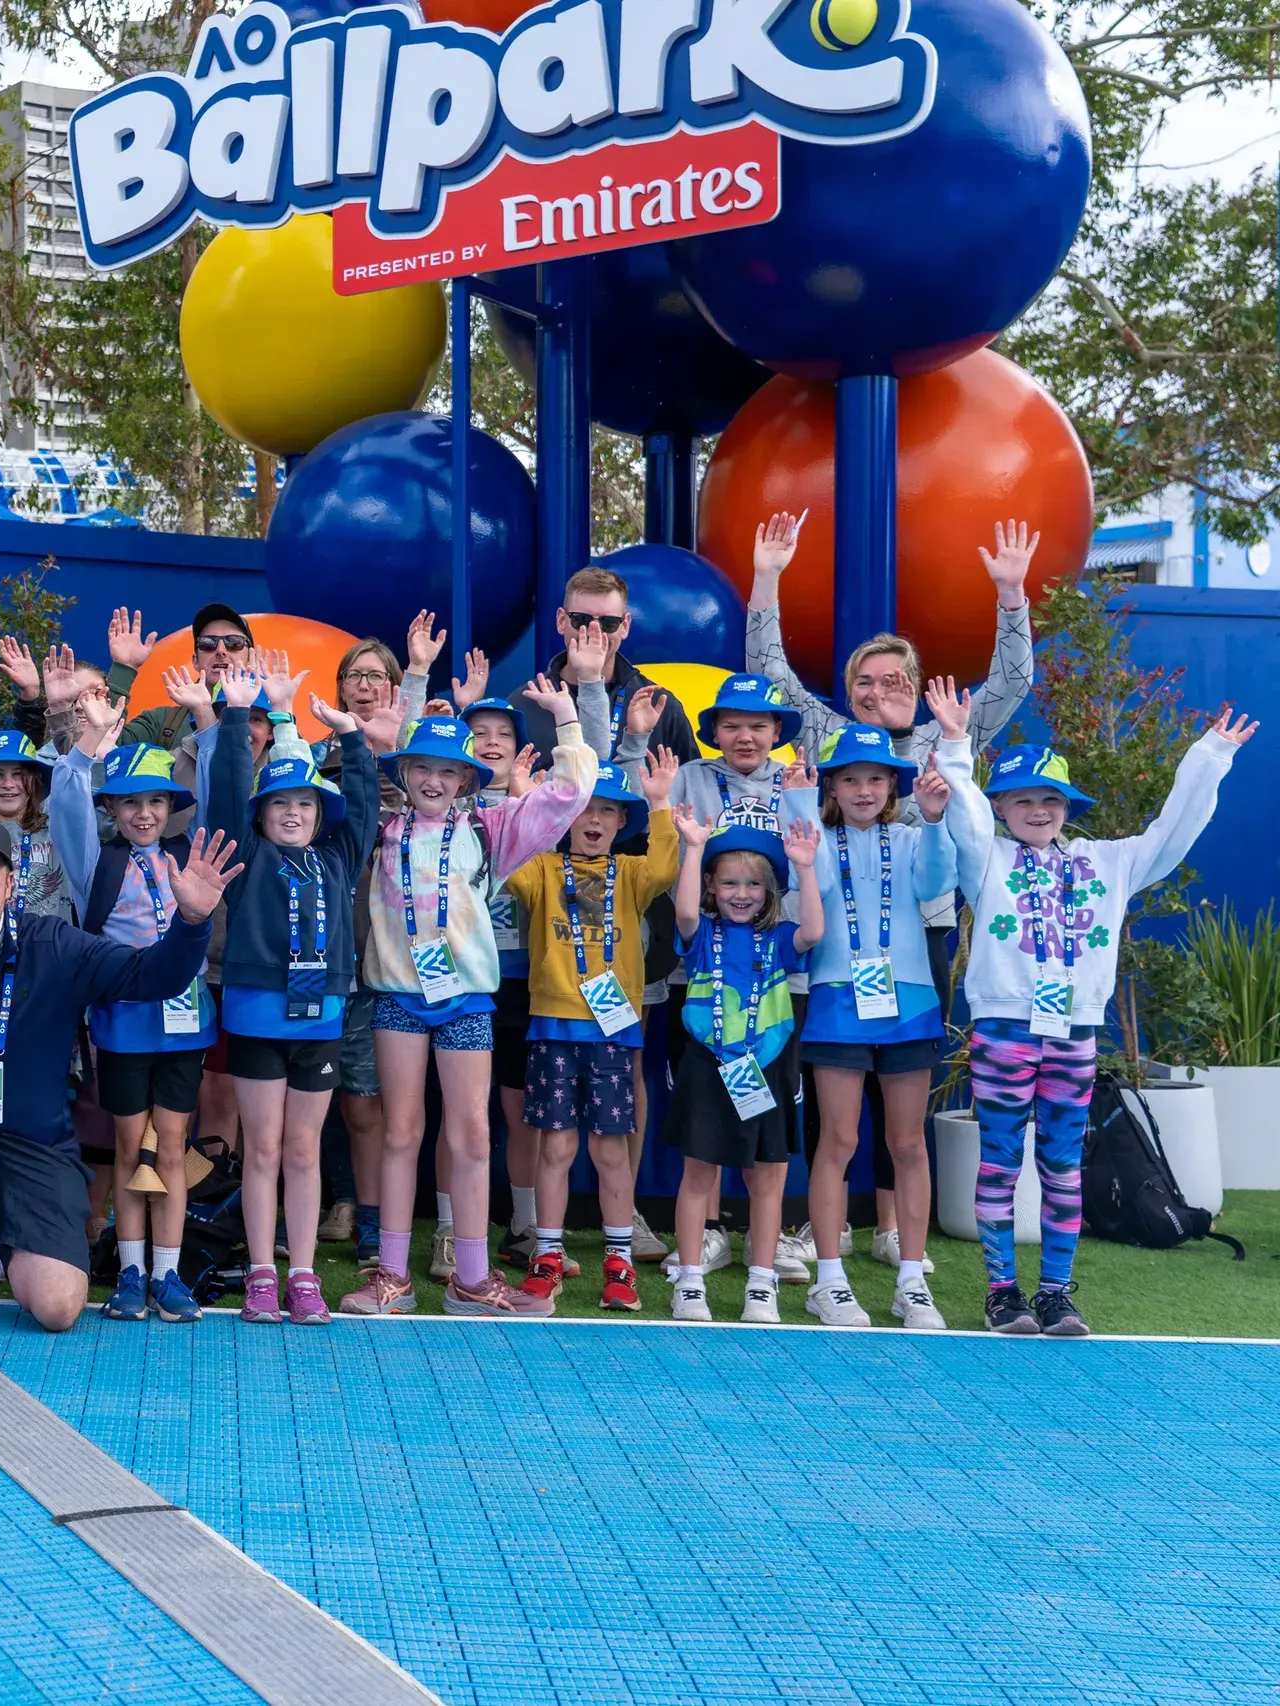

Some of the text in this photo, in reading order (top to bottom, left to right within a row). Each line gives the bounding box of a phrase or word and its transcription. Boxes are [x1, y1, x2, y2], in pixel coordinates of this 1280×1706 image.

[194, 15, 276, 80] AO
[74, 0, 904, 246] Ballpark
[500, 161, 763, 253] Emirates
[343, 243, 488, 282] PRESENTED BY
[614, 713, 619, 721] AO
[771, 803, 776, 811] AO
[24, 836, 28, 844] AO
[841, 852, 846, 861] AO
[883, 849, 889, 857] AO
[142, 863, 148, 871] AO
[1027, 858, 1033, 867] AO
[22, 867, 27, 876] AO
[441, 864, 447, 873] AO
[609, 866, 614, 875] AO
[1065, 863, 1070, 873] AO
[404, 874, 409, 883] AO
[567, 877, 572, 885] AO
[291, 887, 296, 897] AO
[318, 889, 322, 898] AO
[846, 889, 851, 898] AO
[884, 885, 889, 895] AO
[18, 899, 23, 908] AO
[156, 898, 161, 908] AO
[441, 900, 445, 910] AO
[606, 901, 611, 910] AO
[1034, 897, 1039, 907] AO
[1067, 904, 1072, 913] AO
[408, 910, 413, 920] AO
[572, 914, 577, 923] AO
[292, 925, 297, 935] AO
[319, 923, 324, 932] AO
[851, 924, 856, 934] AO
[883, 921, 888, 930] AO
[605, 936, 611, 945] AO
[1038, 934, 1043, 944] AO
[755, 943, 760, 952] AO
[1066, 941, 1072, 951] AO
[578, 948, 583, 957] AO
[715, 955, 720, 964] AO
[5, 985, 10, 995] AO
[753, 982, 758, 992] AO
[715, 995, 721, 1004] AO
[749, 1018, 754, 1028] AO
[0, 1023, 5, 1033] AO
[716, 1031, 720, 1039] AO
